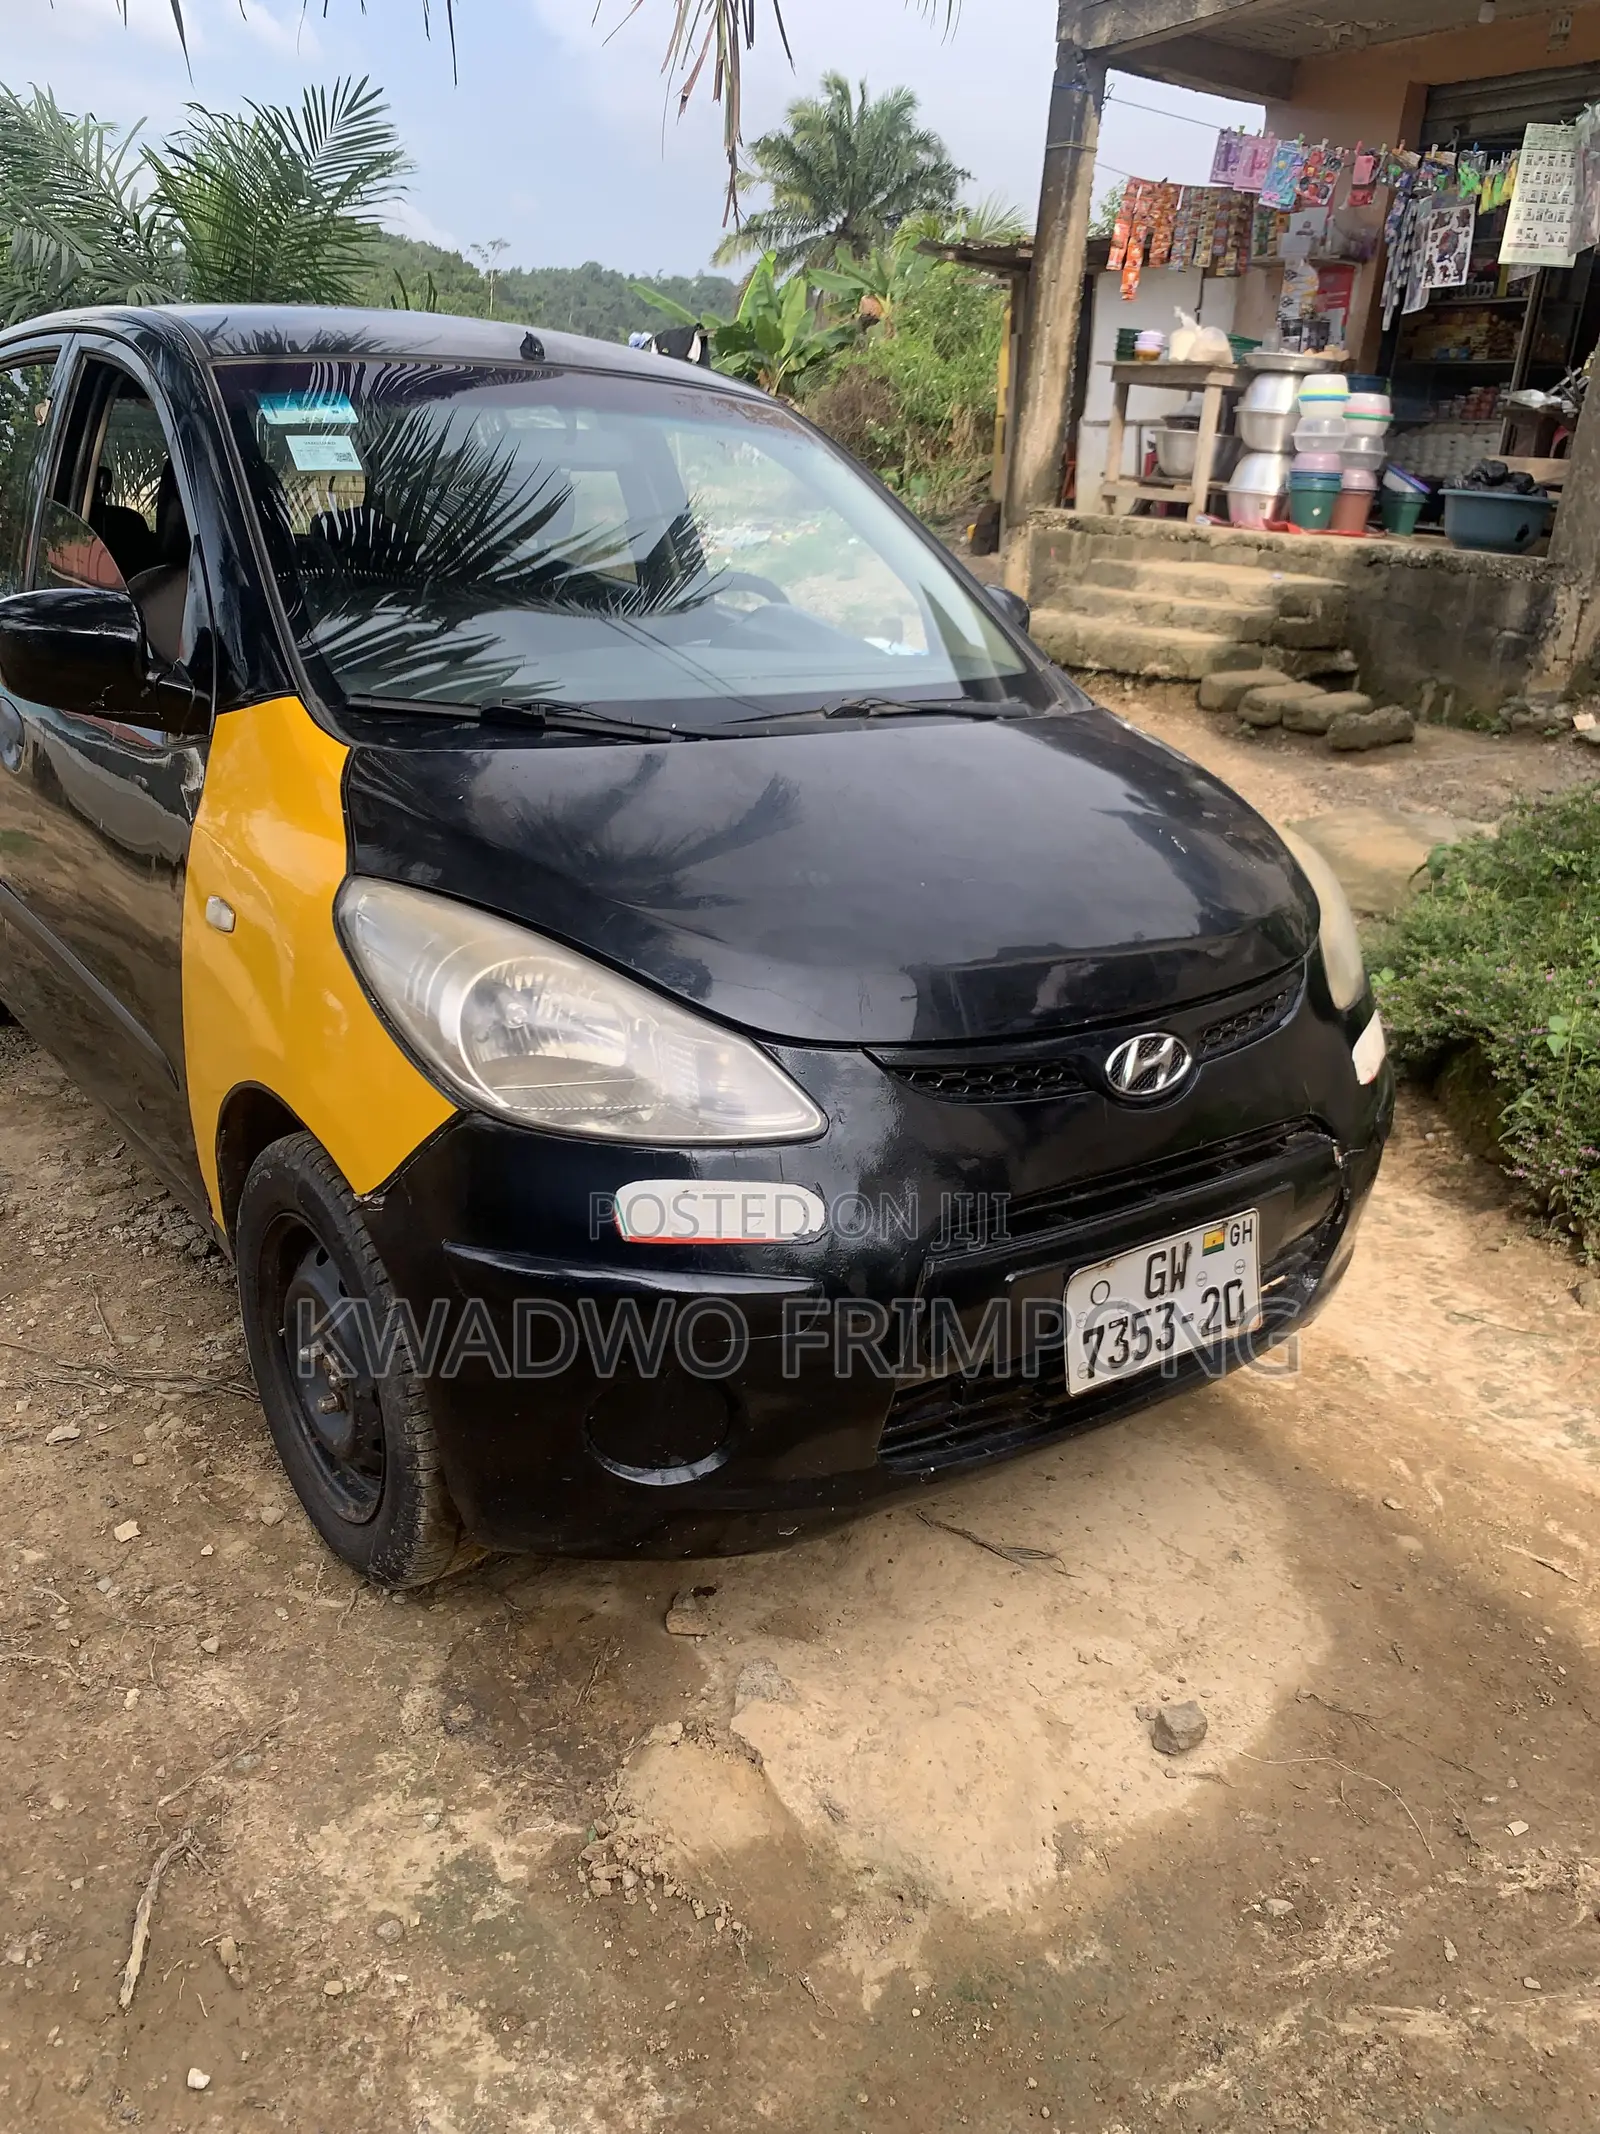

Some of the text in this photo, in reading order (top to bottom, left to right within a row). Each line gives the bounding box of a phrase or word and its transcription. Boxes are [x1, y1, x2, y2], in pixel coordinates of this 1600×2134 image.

[1229, 1218, 1253, 1247] GH
[1144, 1241, 1193, 1299] GW
[1082, 1277, 1246, 1380] 7353-20
